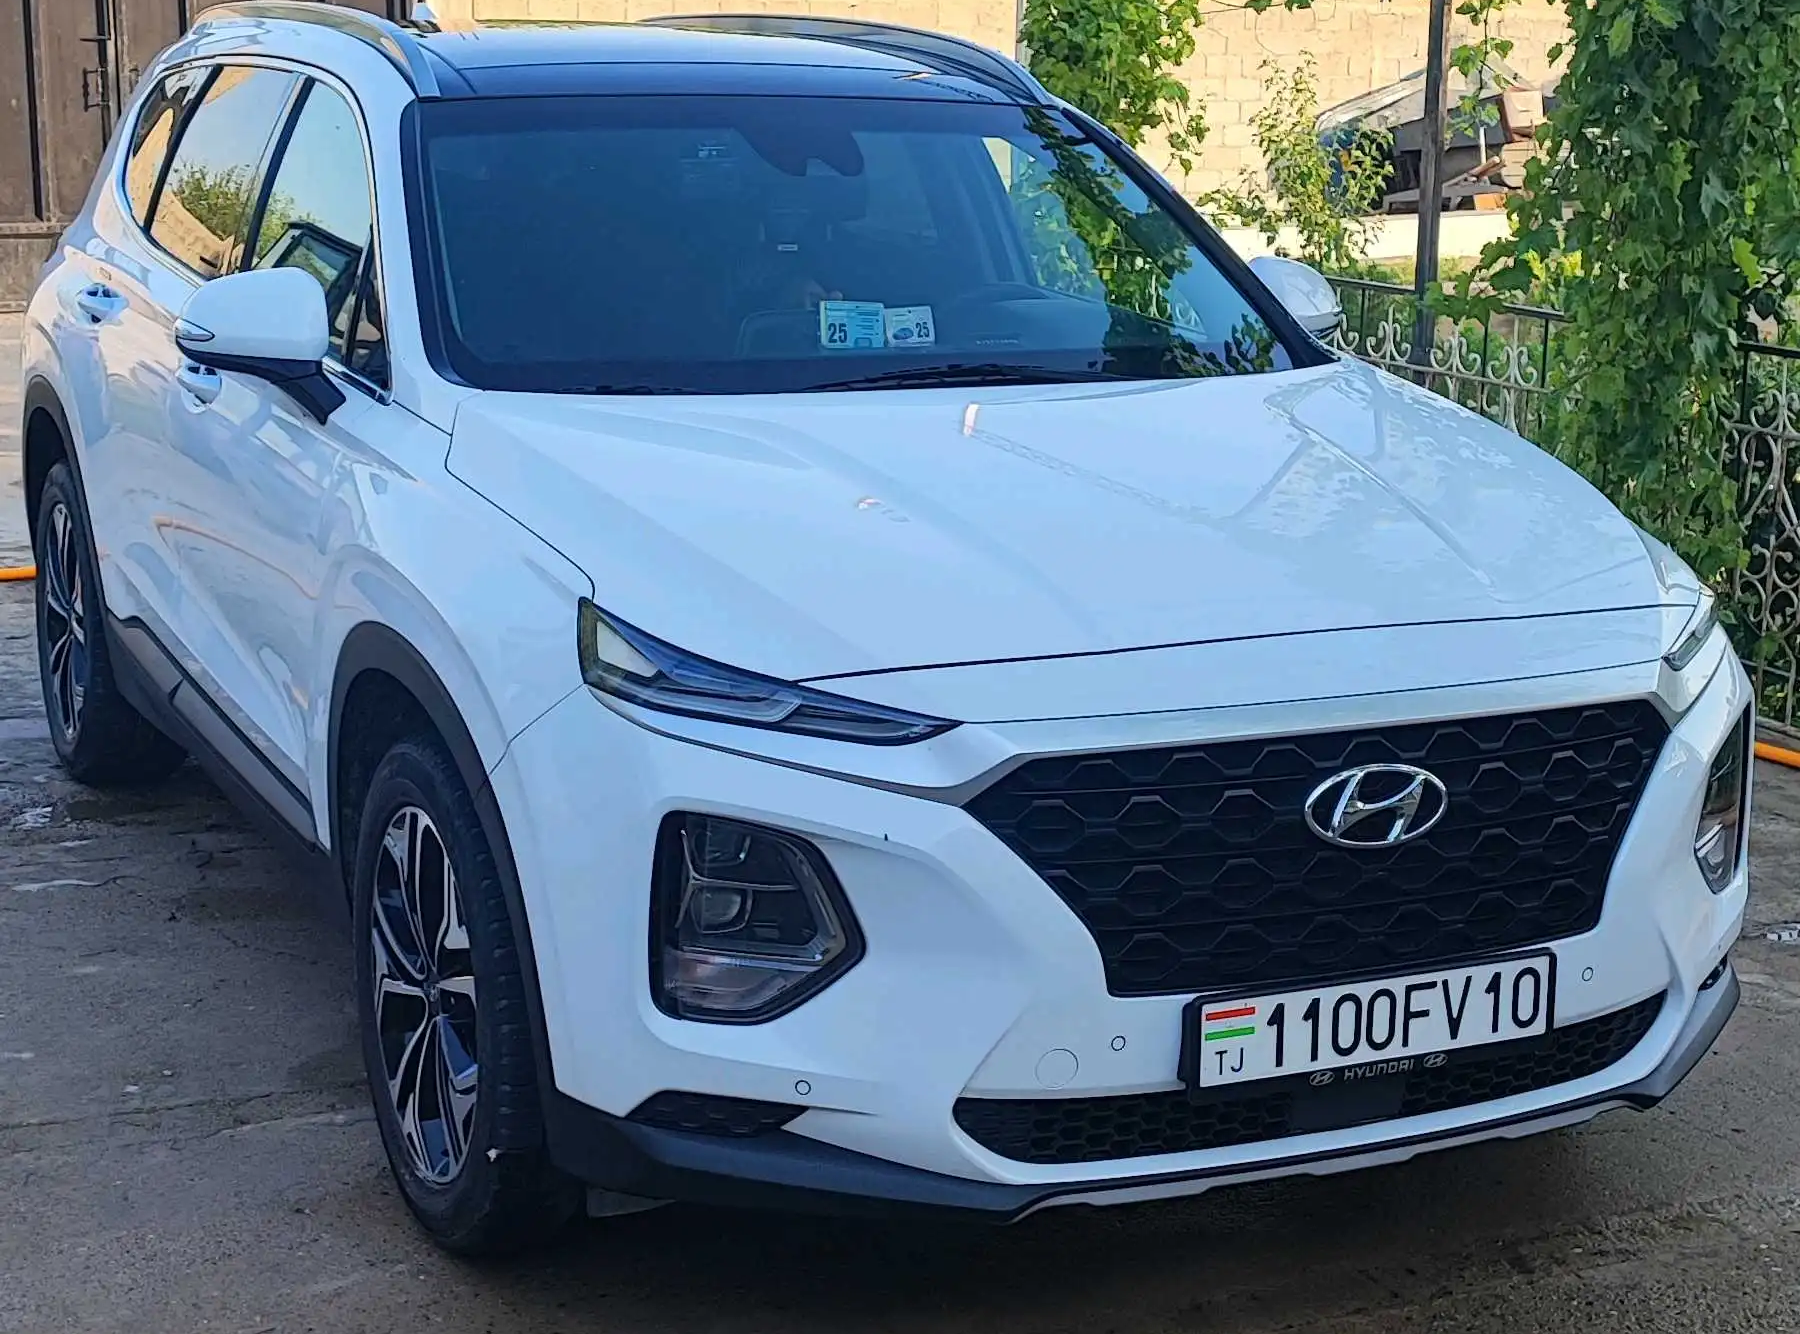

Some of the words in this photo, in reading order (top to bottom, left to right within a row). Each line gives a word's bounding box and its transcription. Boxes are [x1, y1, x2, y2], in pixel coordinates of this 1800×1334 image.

[828, 322, 848, 344] 25
[915, 321, 930, 338] 25
[1266, 966, 1541, 1067] 1100FV10
[1215, 1047, 1244, 1075] TJ
[1344, 1058, 1415, 1080] HYUNDAI
